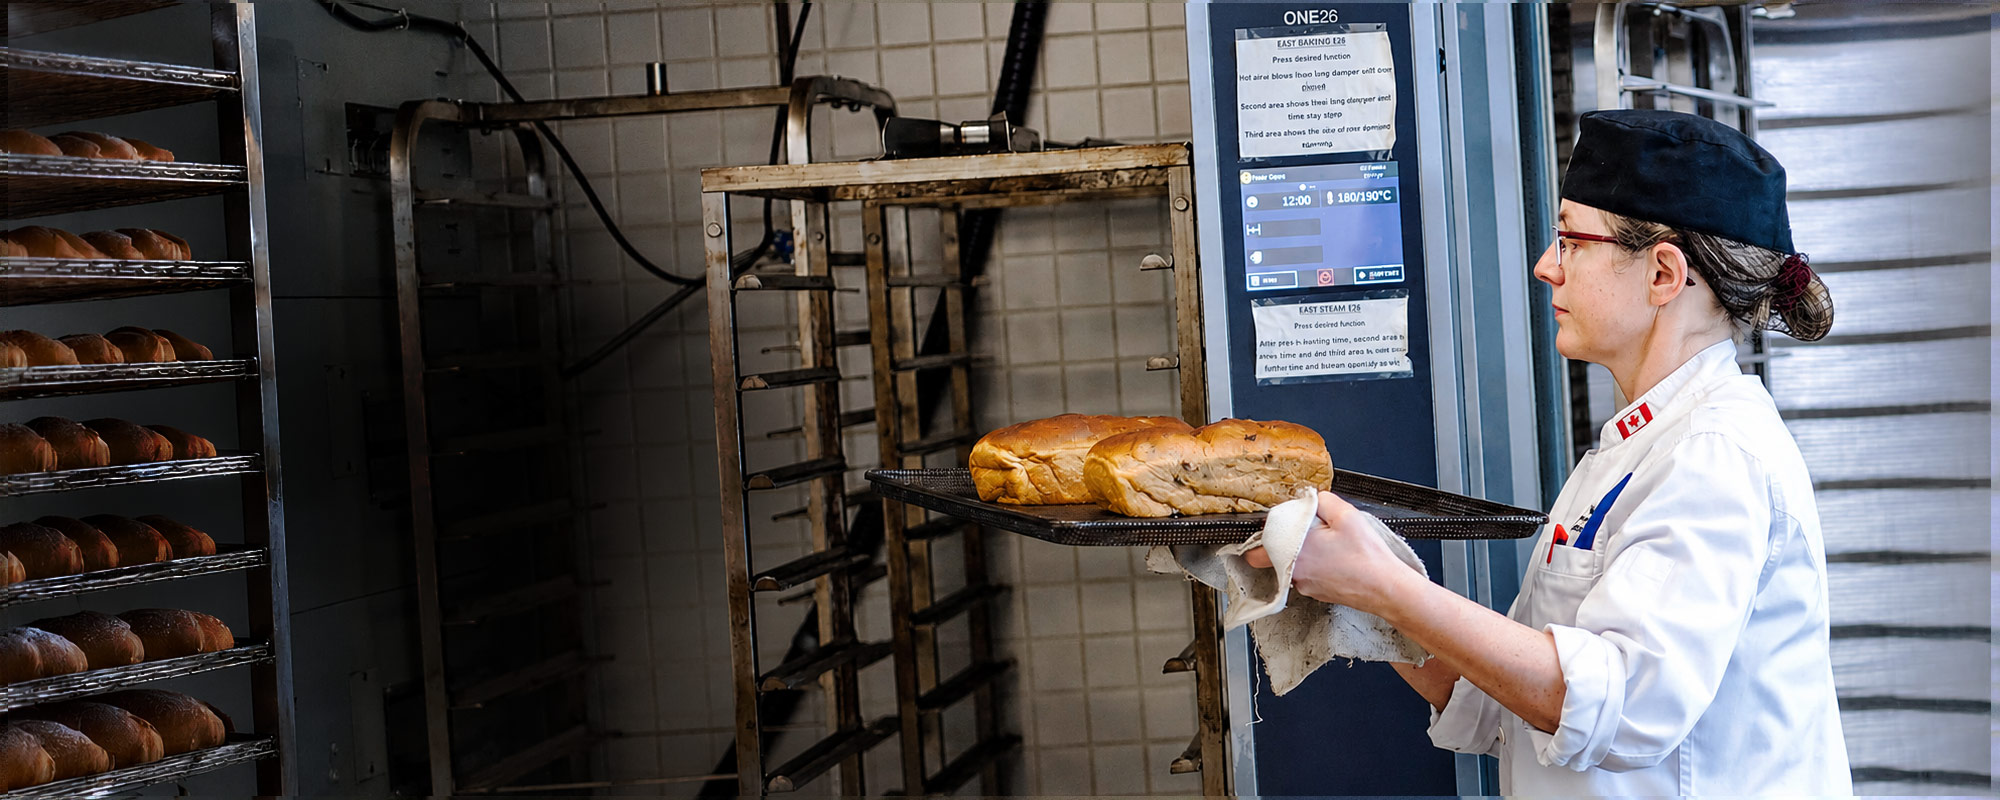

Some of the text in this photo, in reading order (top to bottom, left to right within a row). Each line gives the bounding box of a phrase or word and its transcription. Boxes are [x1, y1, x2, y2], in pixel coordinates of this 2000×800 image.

[1284, 9, 1338, 25] ONE26
[1277, 39, 1296, 48] EAST
[1272, 55, 1293, 64] Press
[1295, 54, 1322, 62] desired
[1331, 69, 1360, 78] damper
[1240, 102, 1267, 110] Second
[1306, 112, 1322, 121] stay
[1245, 130, 1264, 138] Third
[1265, 130, 1282, 138] area
[1282, 195, 1312, 206] 12:00
[1299, 305, 1318, 314] EAST
[1319, 304, 1346, 313] STEAM
[1299, 350, 1312, 358] and
[1305, 362, 1319, 370] and
